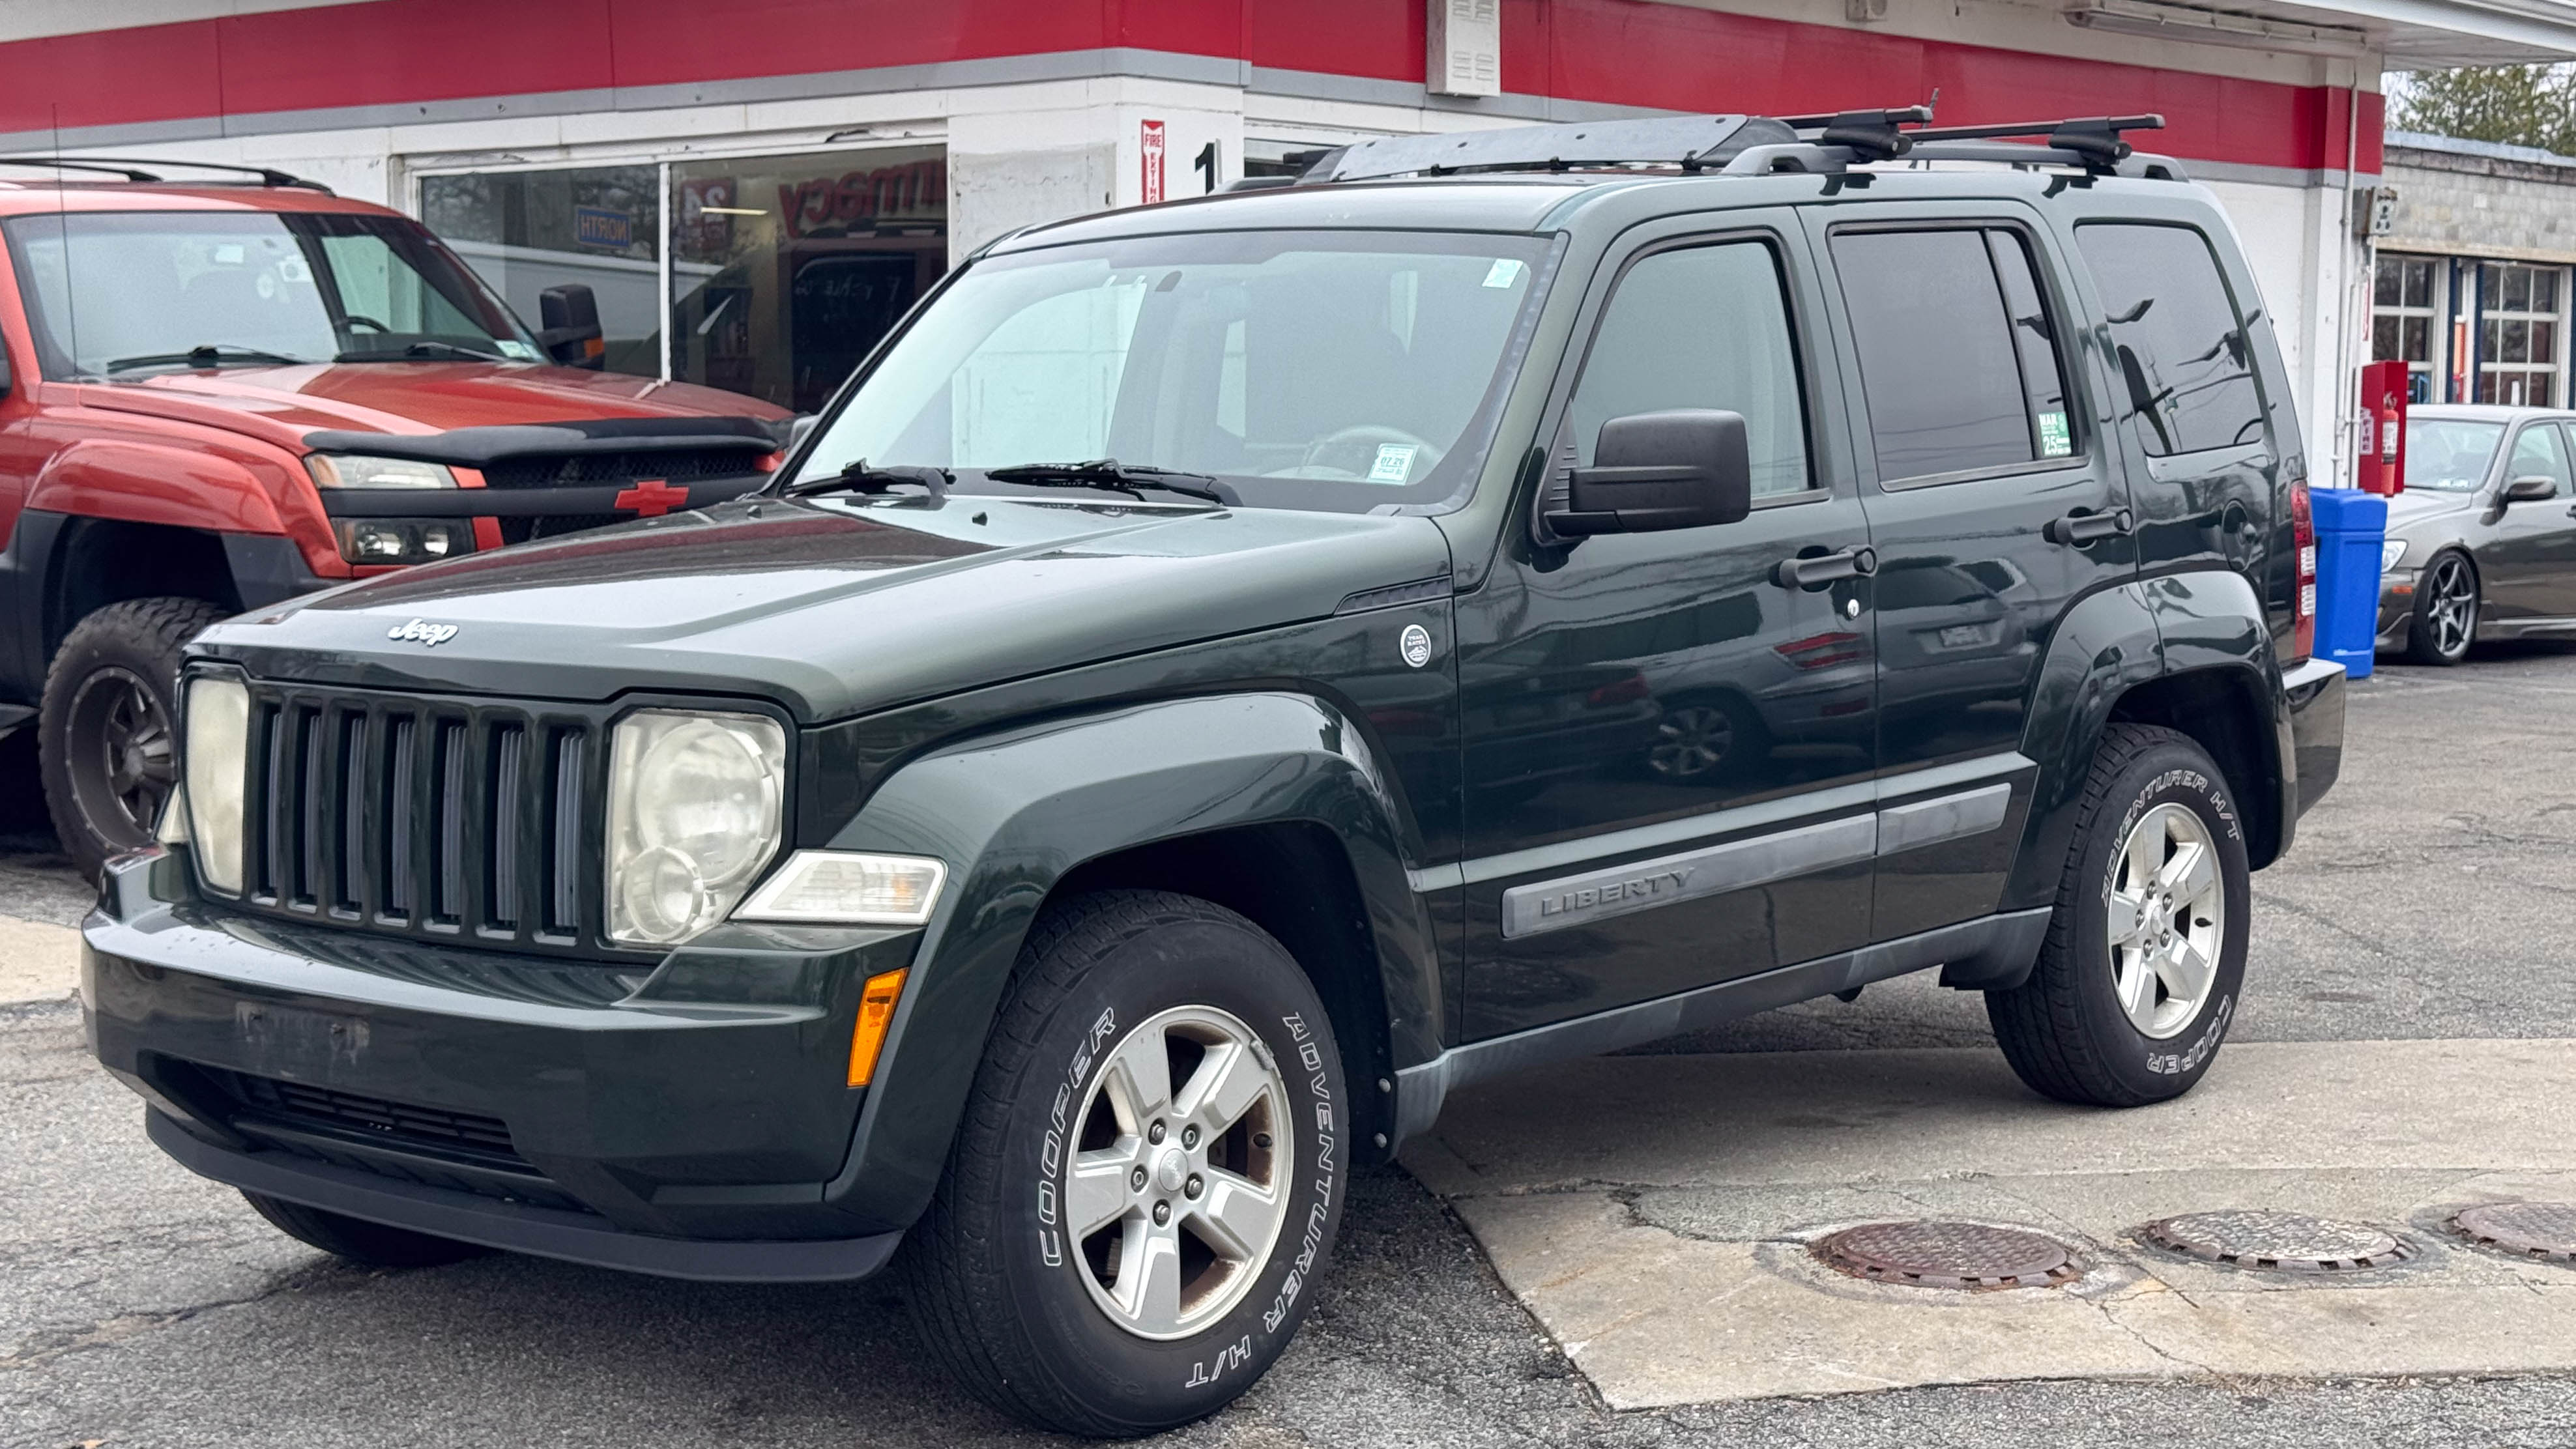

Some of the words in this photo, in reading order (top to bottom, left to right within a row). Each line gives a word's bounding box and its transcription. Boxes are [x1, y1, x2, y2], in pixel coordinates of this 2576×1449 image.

[1145, 134, 1162, 147] FIRE
[2038, 414, 2058, 426] MAR
[2043, 436, 2058, 455] 25
[388, 618, 459, 646] Jeep
[2102, 769, 2208, 908] ADVENTURER
[2210, 790, 2240, 841] H/T
[1541, 867, 1696, 917] LIBERTY
[2147, 994, 2232, 1076] COOPER
[1038, 1006, 1116, 1267] COOPER
[1263, 1011, 1334, 1334] ADVENTURER
[1185, 1335, 1252, 1389] H/T
